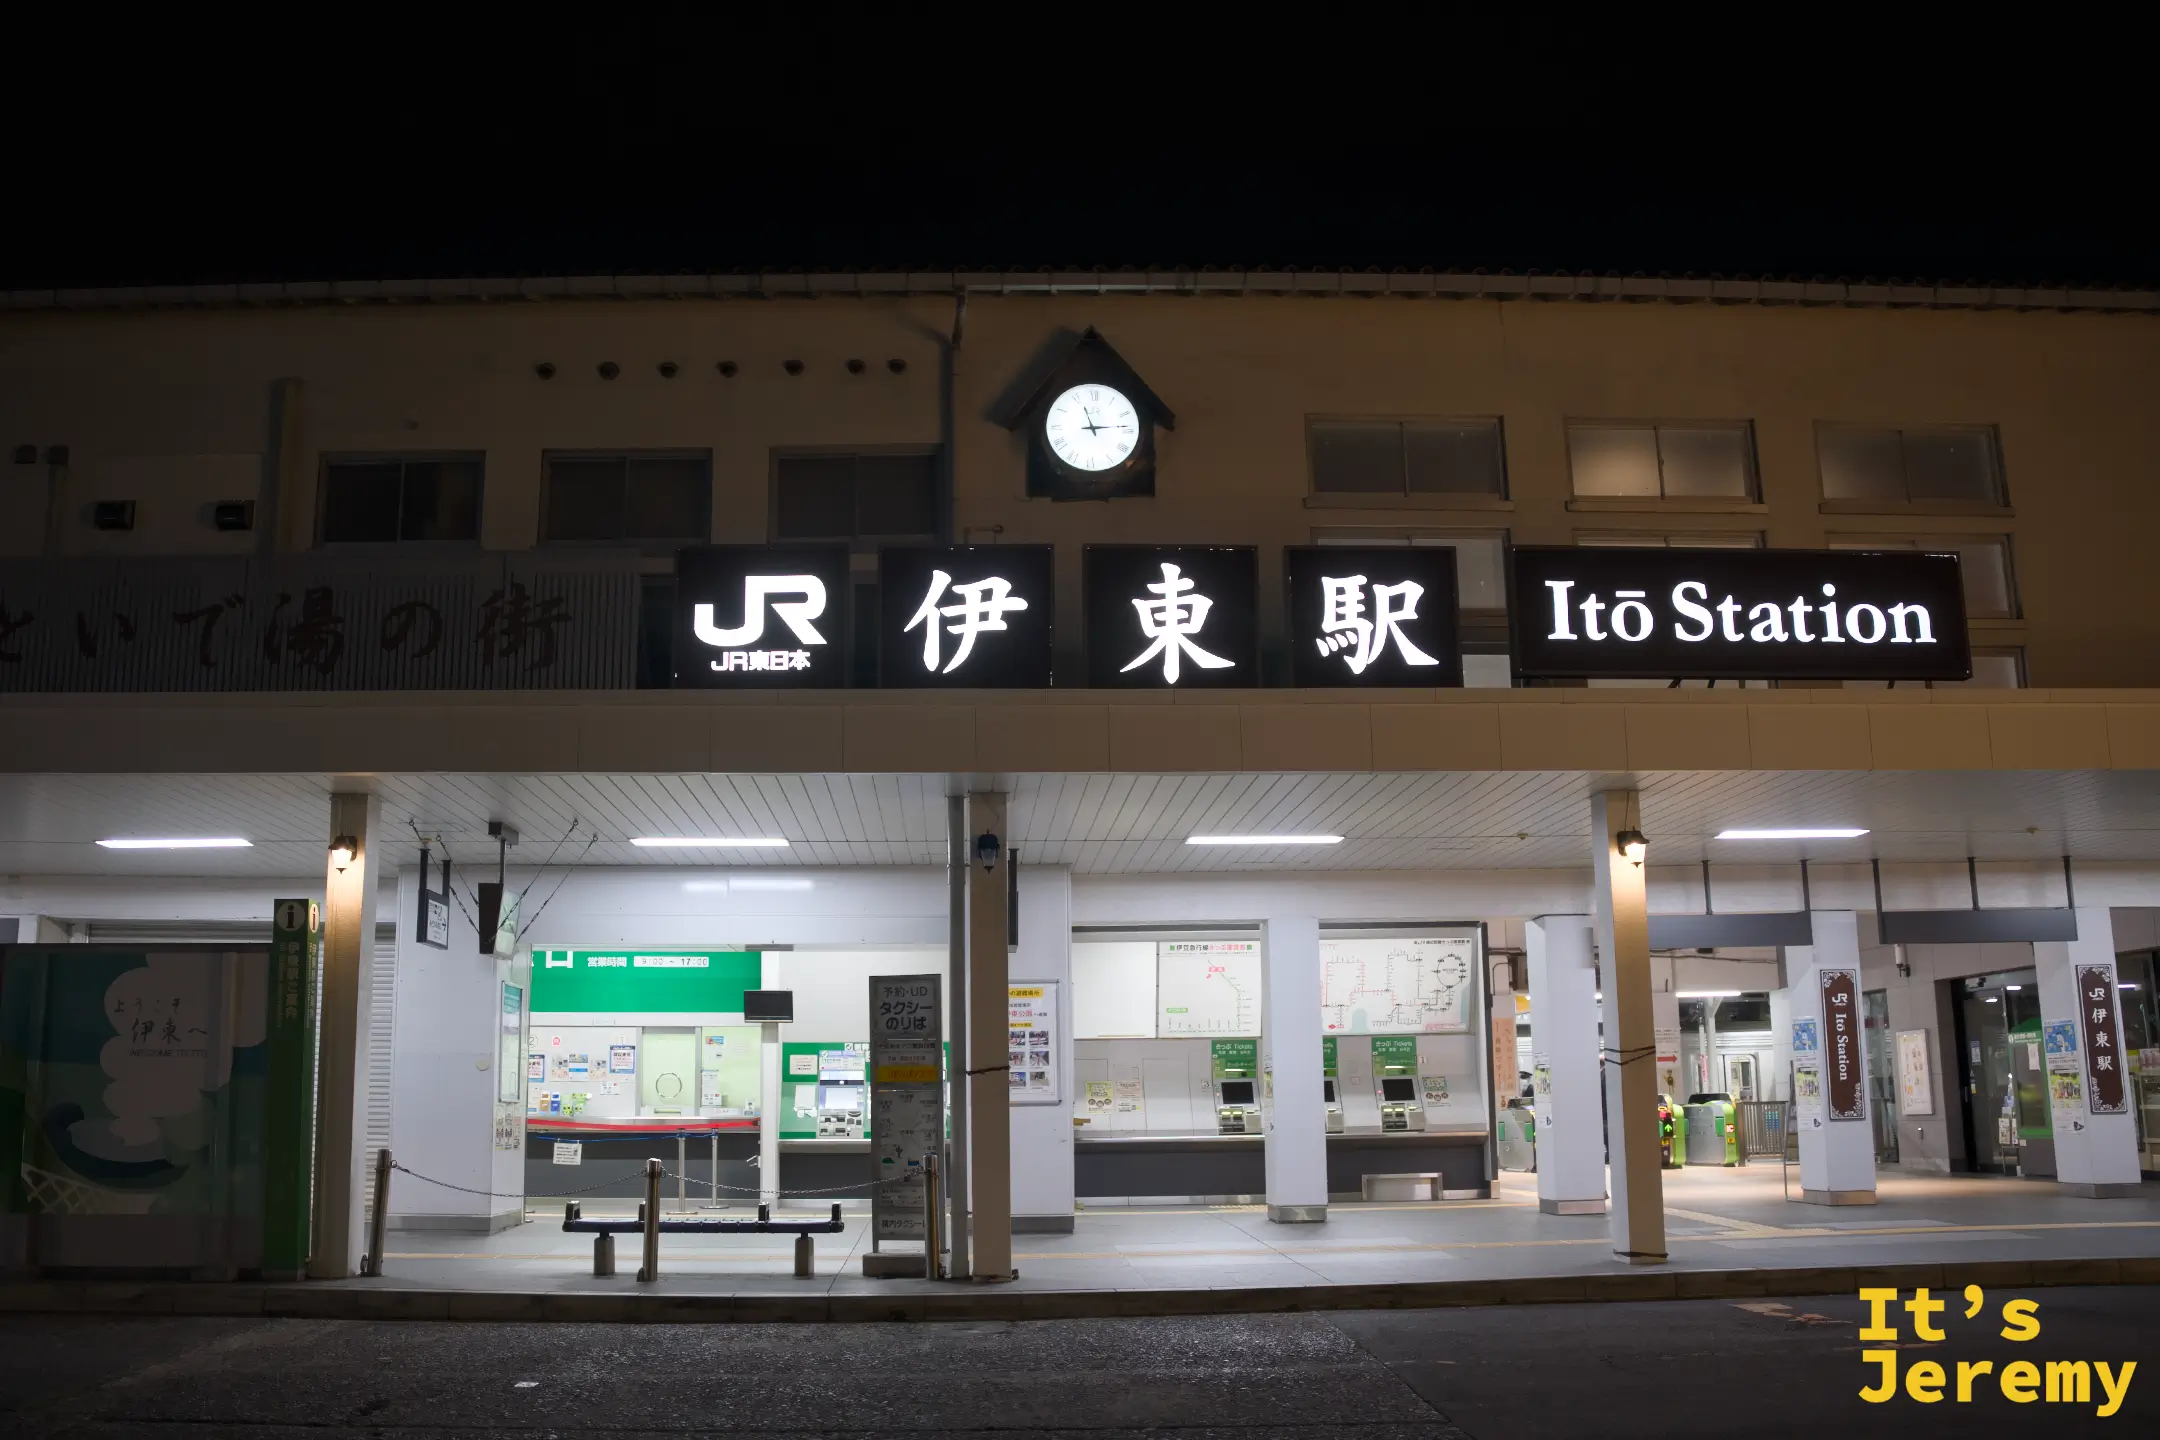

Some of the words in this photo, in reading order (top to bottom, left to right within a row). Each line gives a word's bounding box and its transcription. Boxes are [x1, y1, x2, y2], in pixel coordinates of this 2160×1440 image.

[694, 575, 827, 646] JR
[1545, 581, 1654, 641] Itō
[1672, 582, 1937, 643] Station
[904, 563, 1439, 683] 伊東駅
[711, 649, 811, 671] JR東日本
[1832, 993, 1848, 1003] JR
[2089, 987, 2105, 998] JR
[880, 1001, 933, 1016] タクシー
[1009, 1009, 1033, 1018] 東公園
[131, 1017, 208, 1044] 伊東へ
[886, 1017, 927, 1030] のりば
[2092, 1007, 2113, 1071] 伊東駅
[1837, 1034, 1850, 1081] Station
[882, 1219, 925, 1229] 構内タクシー
